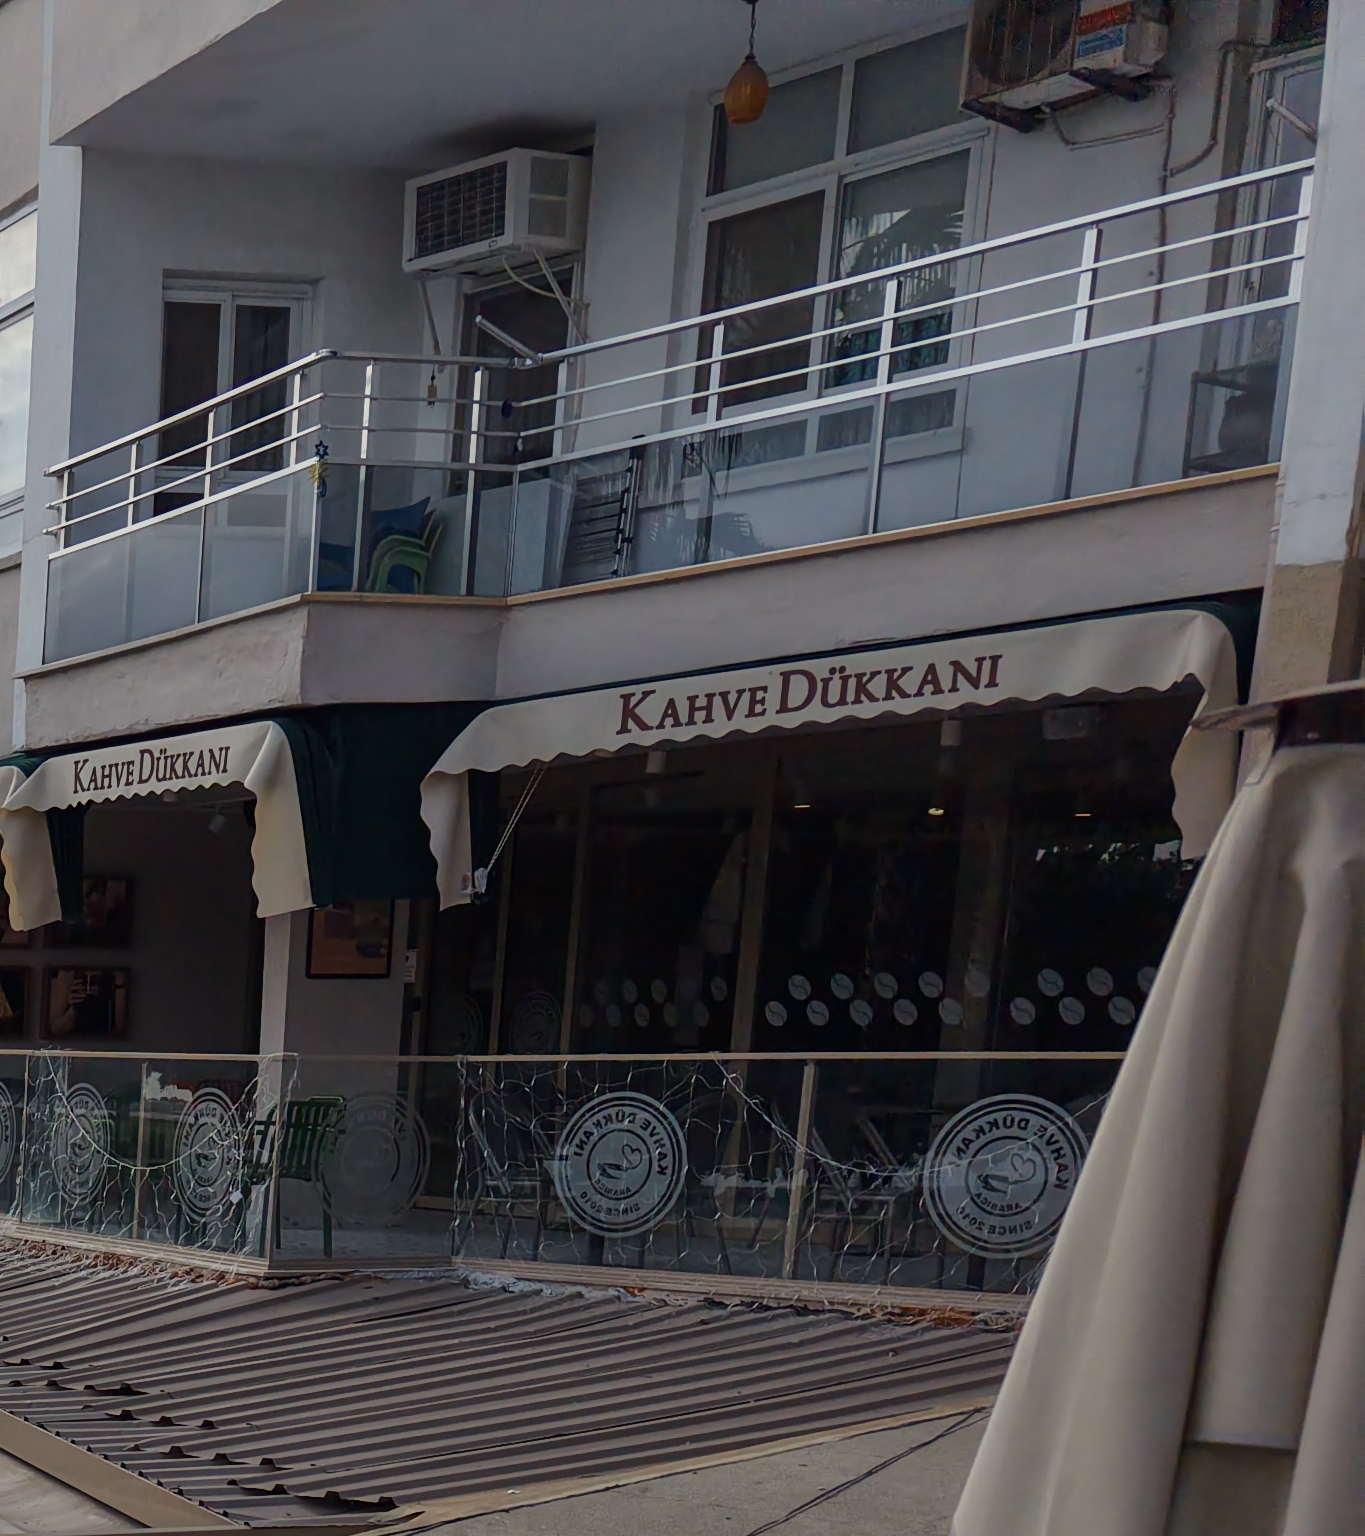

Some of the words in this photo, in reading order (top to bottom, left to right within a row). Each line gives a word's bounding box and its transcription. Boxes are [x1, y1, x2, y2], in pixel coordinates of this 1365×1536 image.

[615, 689, 769, 735] KAHVE
[775, 653, 1003, 715] DÜKKANI
[73, 758, 135, 794] KAHVE
[137, 746, 231, 785] DÜKKANI
